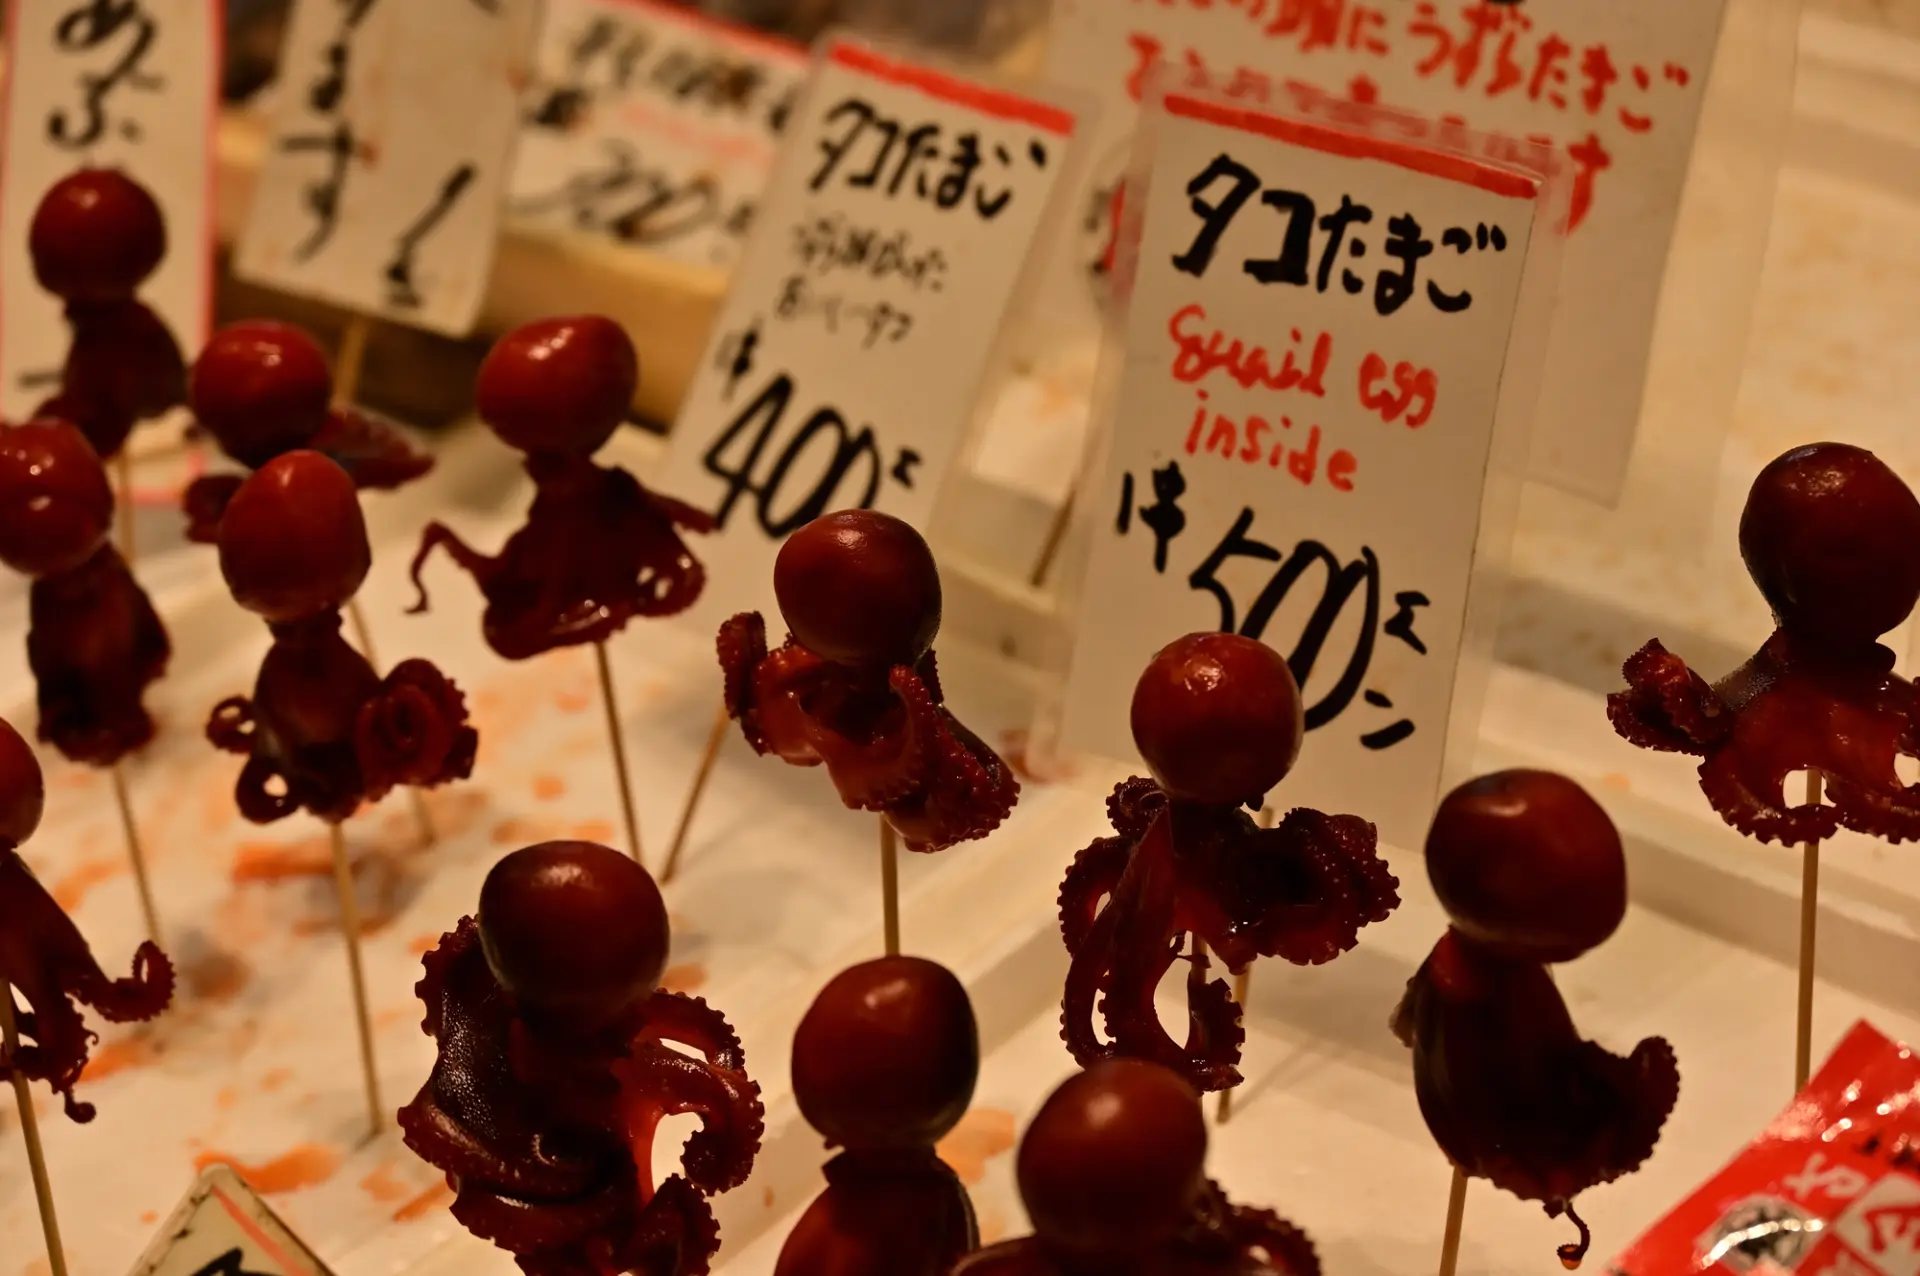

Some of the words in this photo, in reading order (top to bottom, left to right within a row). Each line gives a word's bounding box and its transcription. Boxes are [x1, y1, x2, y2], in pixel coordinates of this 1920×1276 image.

[1171, 152, 1508, 316] タコたまご
[1183, 388, 1358, 493] inside
[1357, 351, 1439, 429] egg
